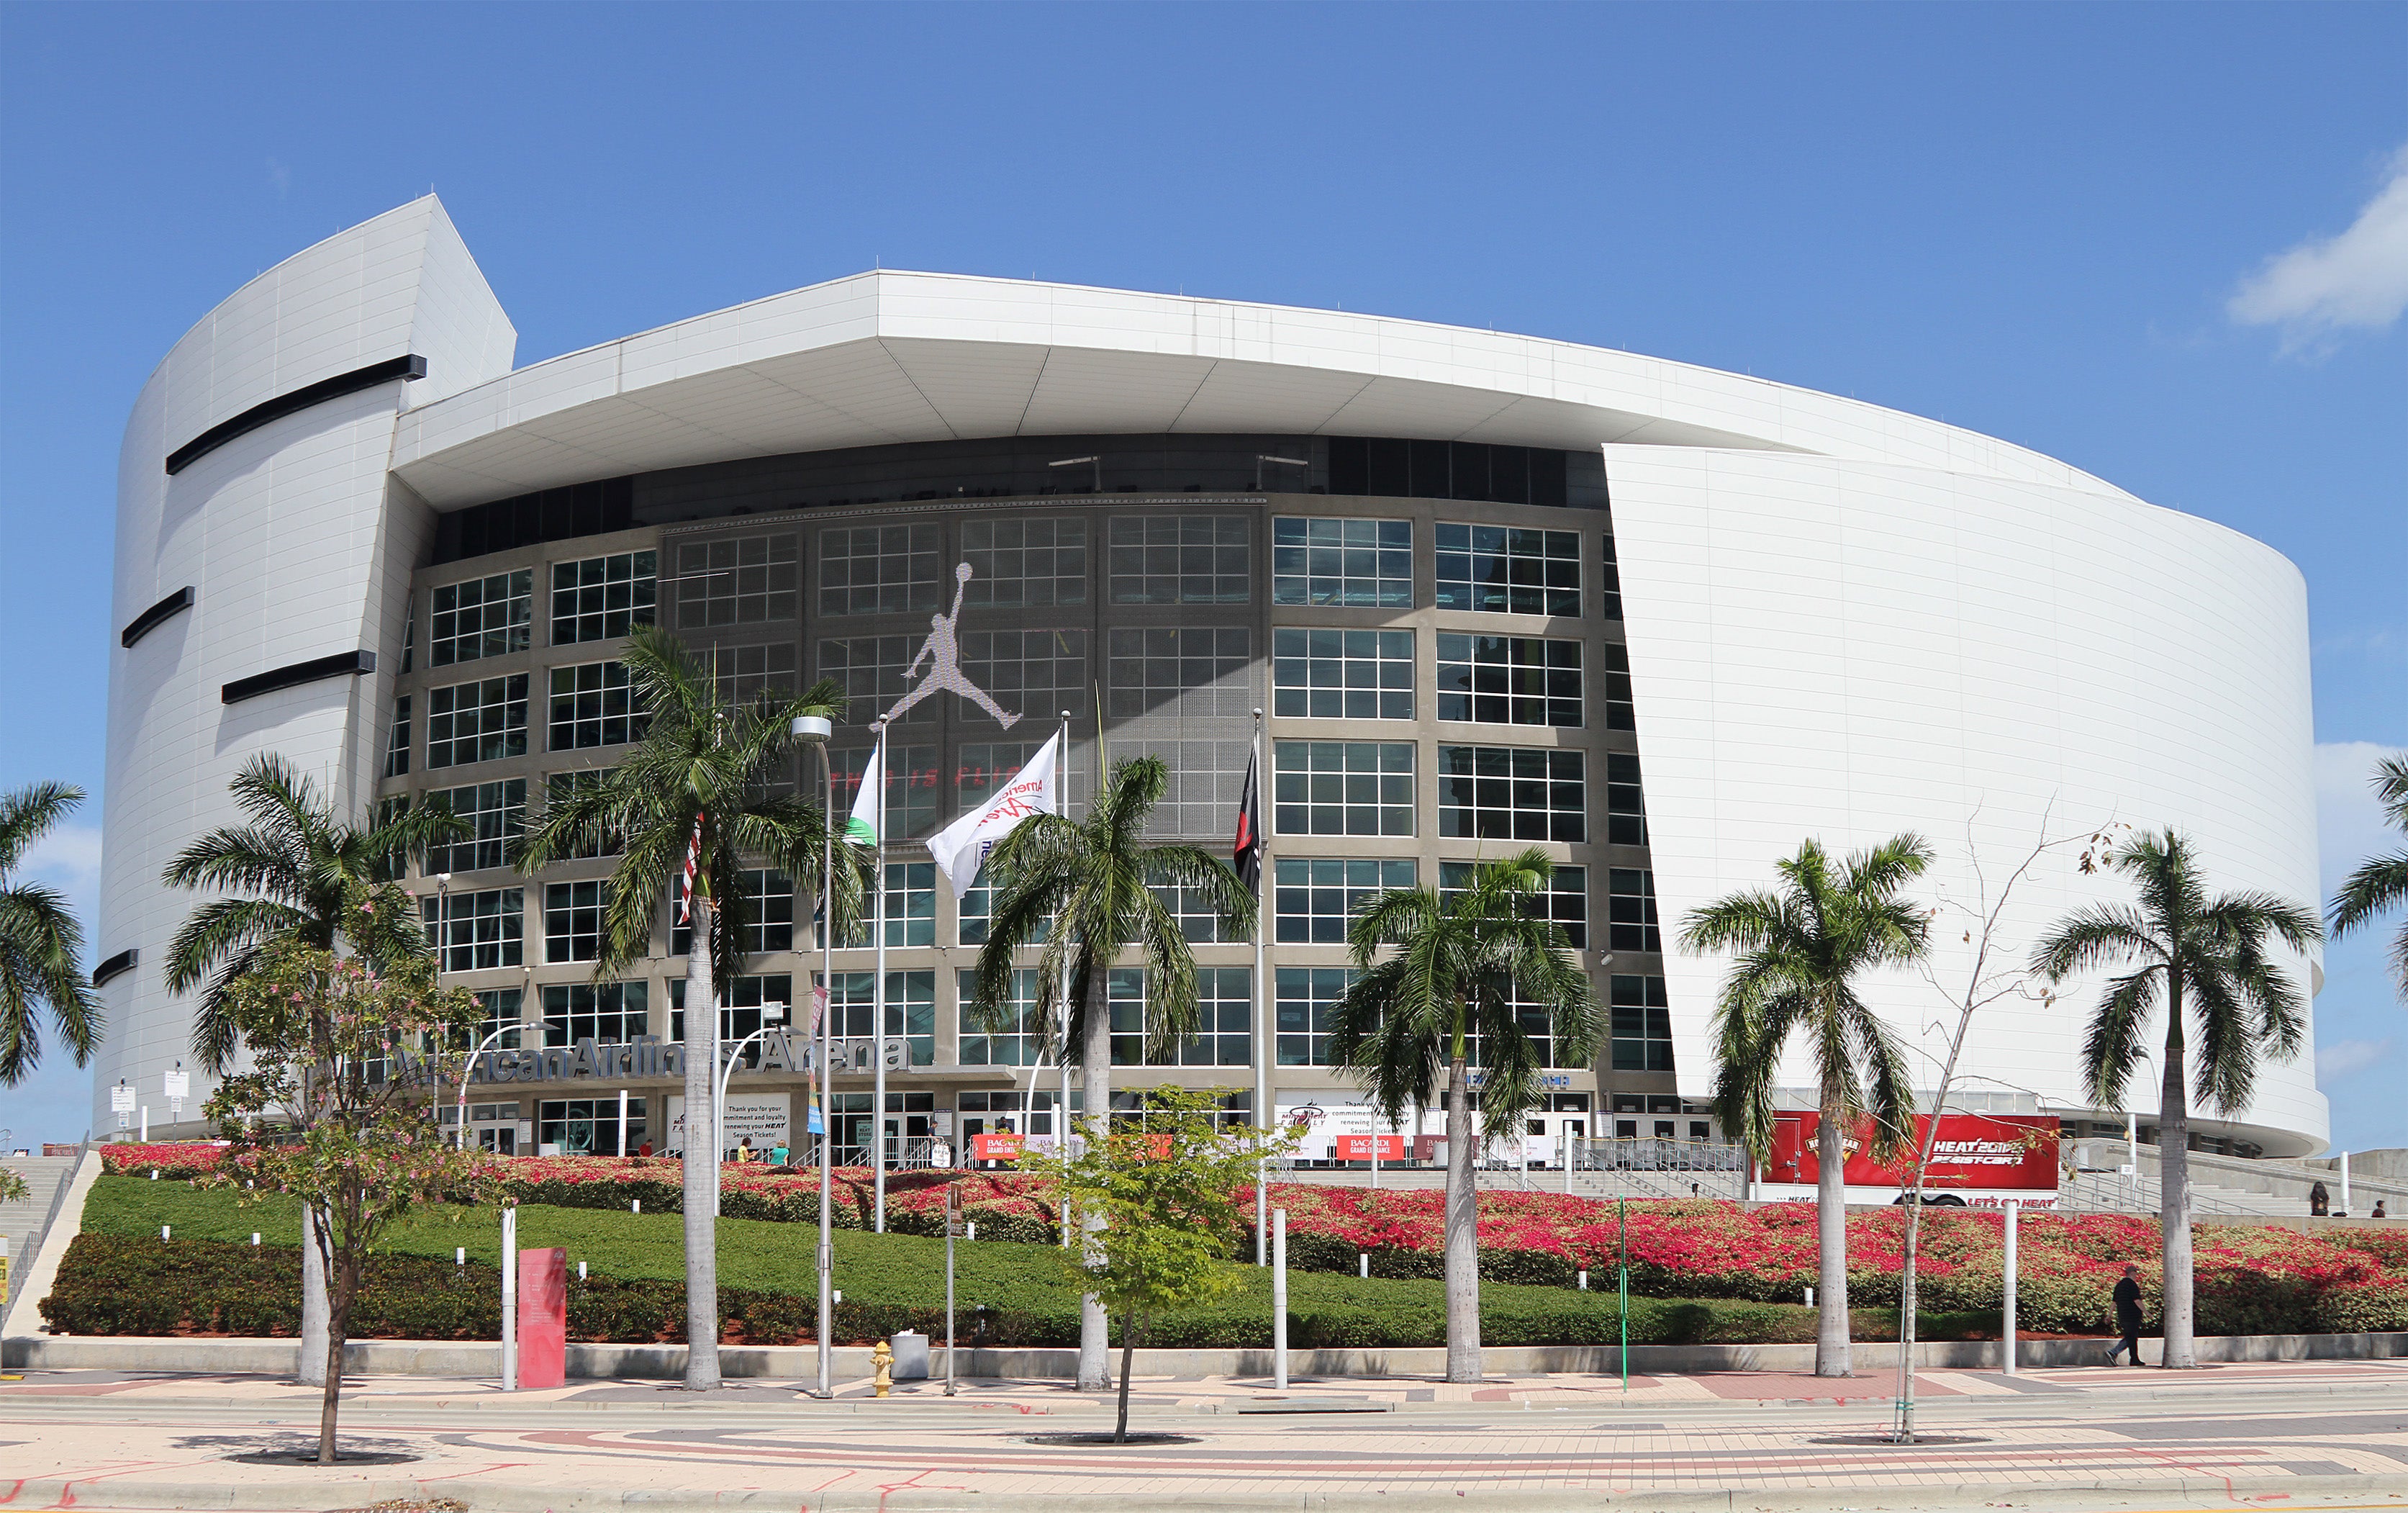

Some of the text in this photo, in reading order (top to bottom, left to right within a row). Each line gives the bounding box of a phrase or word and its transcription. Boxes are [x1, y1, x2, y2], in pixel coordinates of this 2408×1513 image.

[830, 772, 894, 790] THS
[756, 1031, 912, 1072] Arena
[1932, 1137, 1982, 1152] HEAT
[1968, 1196, 1999, 1208] LET'S
[2021, 1197, 2058, 1209] HEAT
